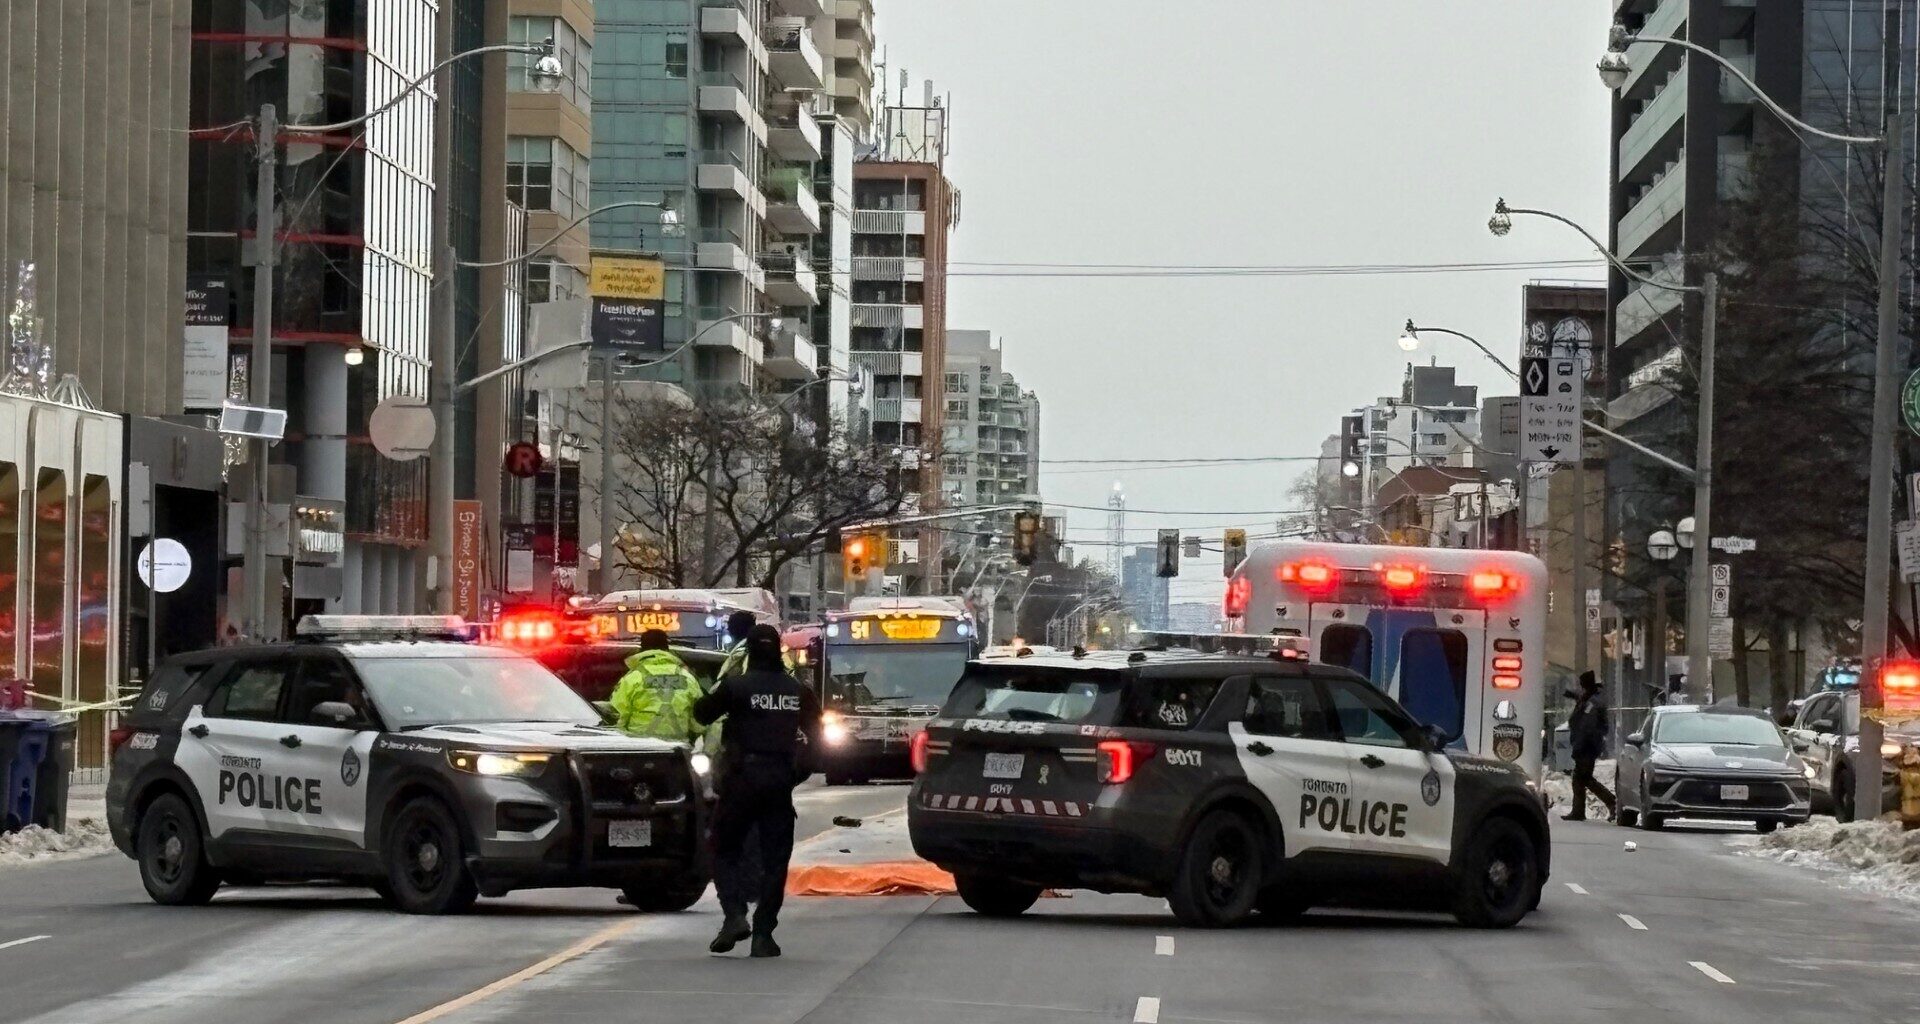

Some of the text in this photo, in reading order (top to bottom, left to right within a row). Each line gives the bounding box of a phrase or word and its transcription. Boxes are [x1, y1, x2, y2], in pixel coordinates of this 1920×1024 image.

[750, 694, 801, 711] POLICE
[221, 755, 262, 769] TORONTO
[1165, 748, 1202, 768] 6017
[219, 769, 322, 815] POLICE
[1302, 779, 1347, 795] TORONTO
[1299, 793, 1408, 838] POLICE
